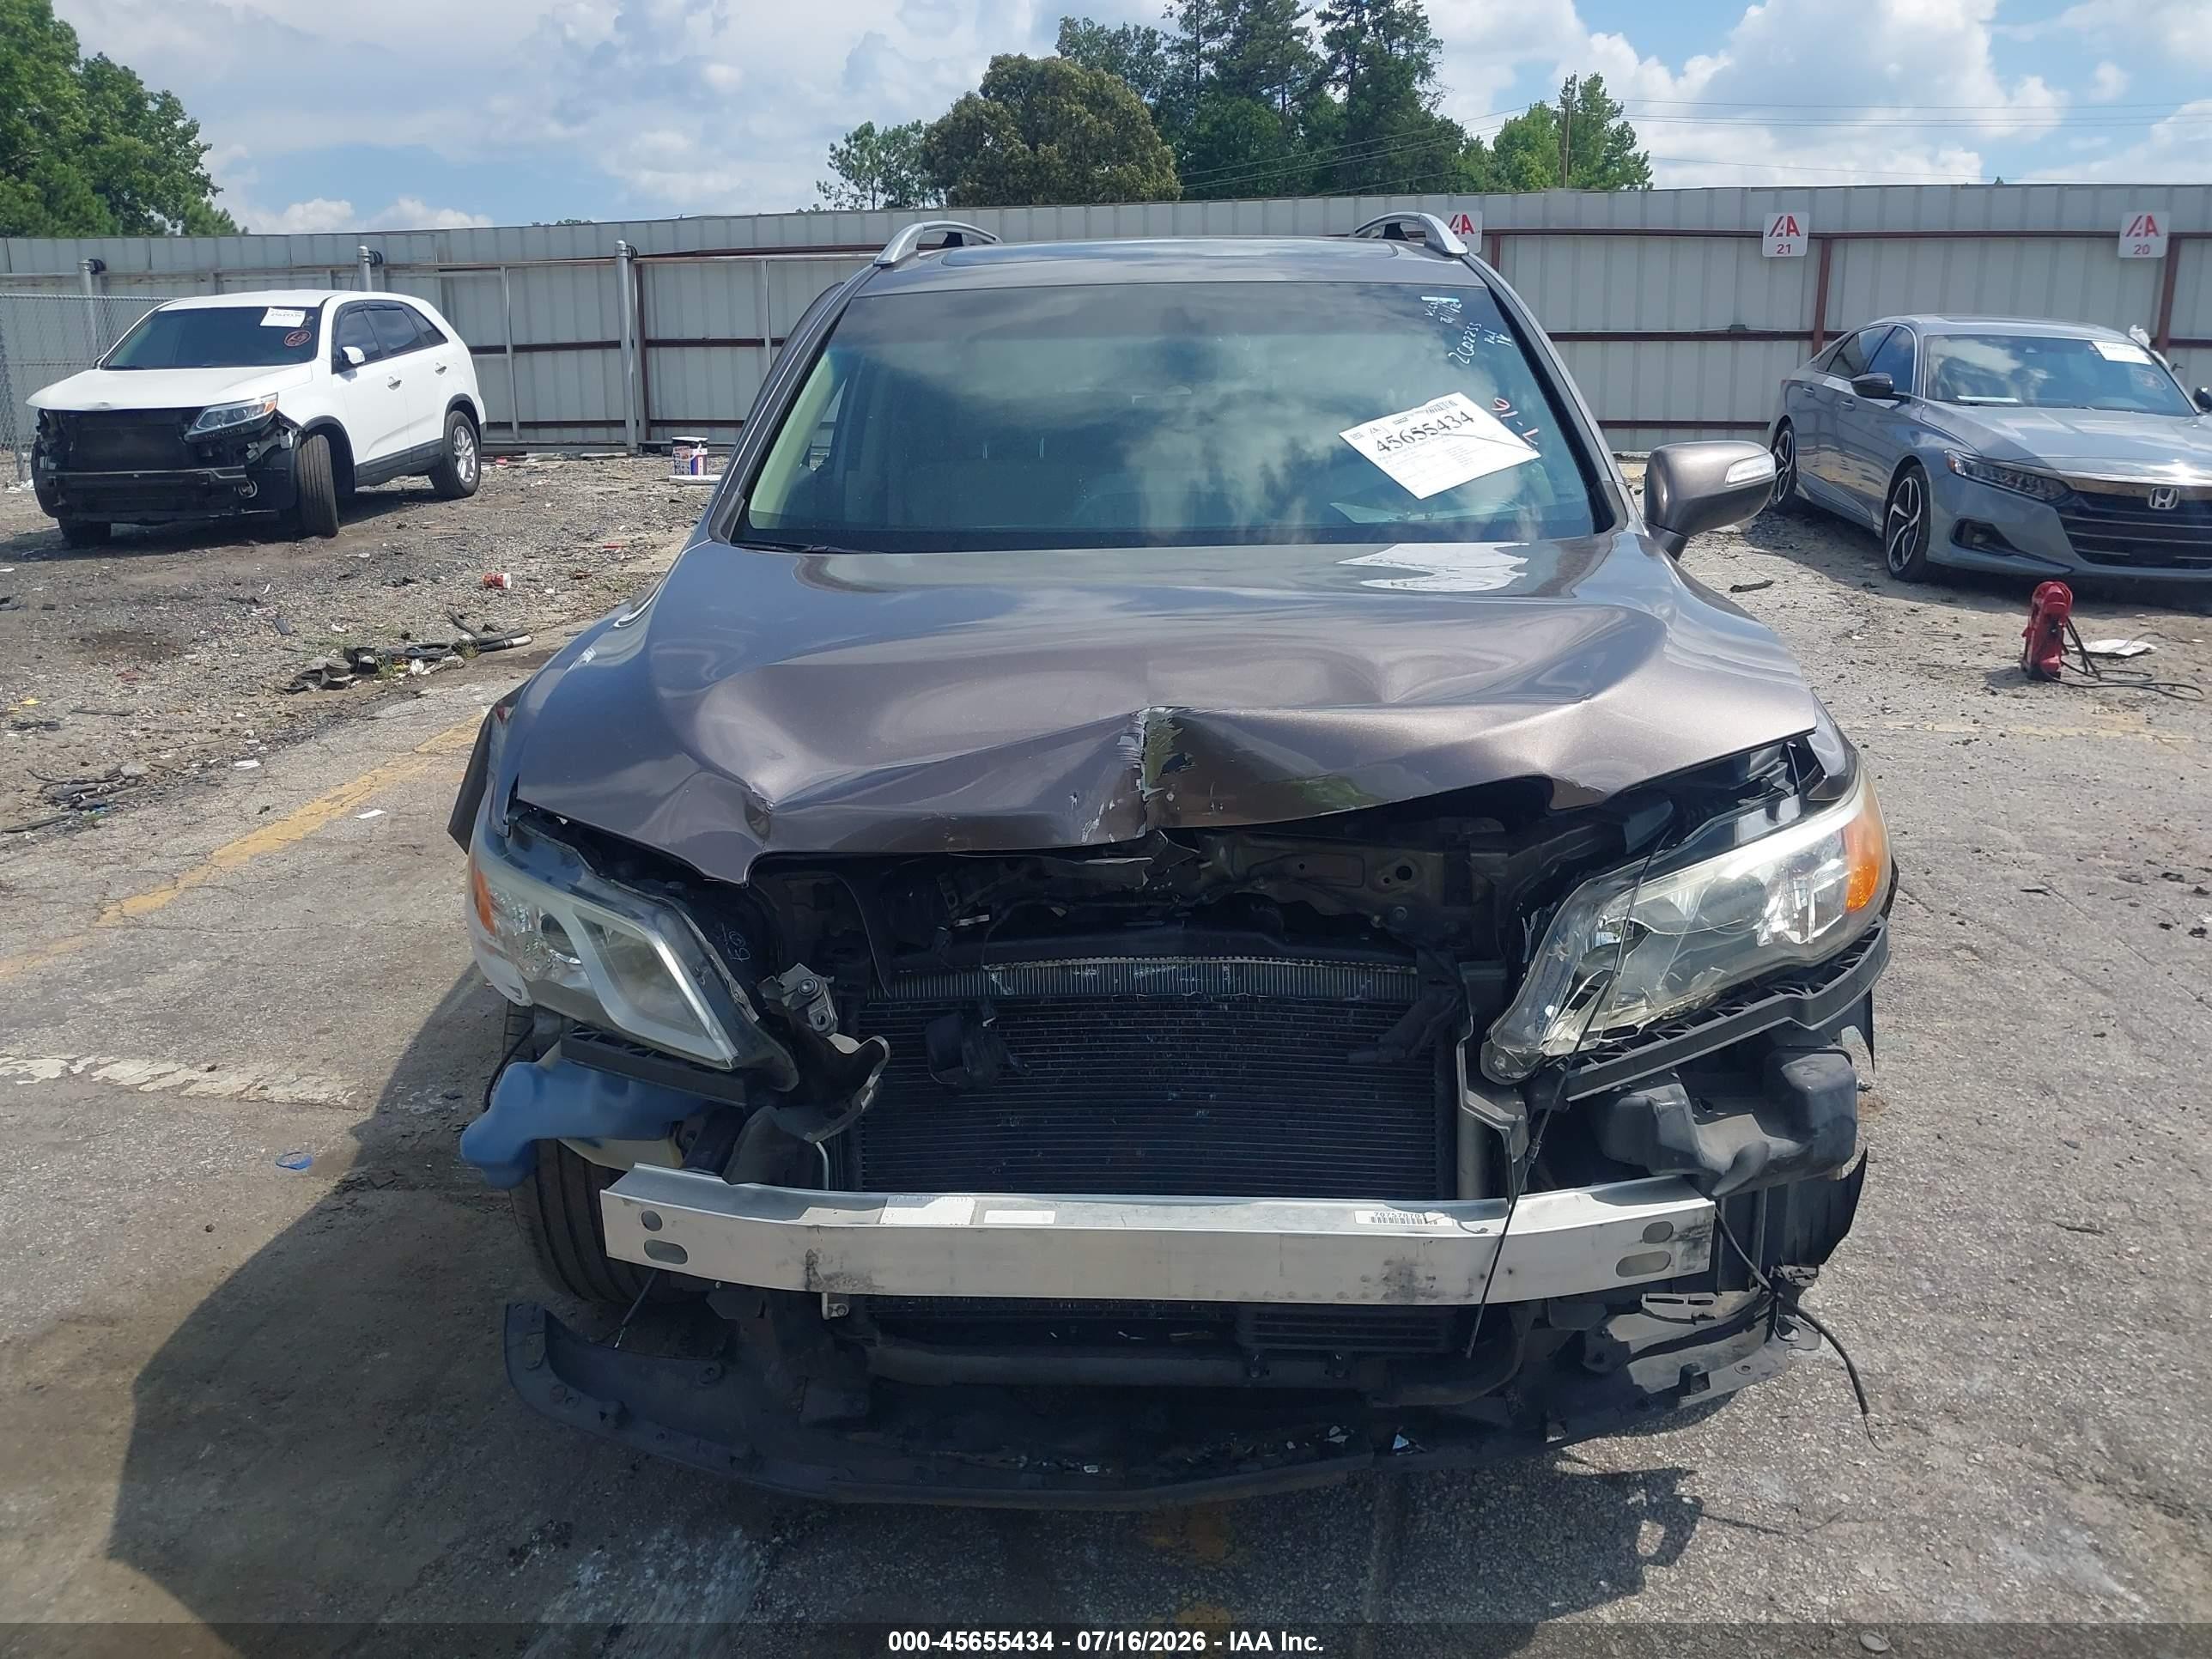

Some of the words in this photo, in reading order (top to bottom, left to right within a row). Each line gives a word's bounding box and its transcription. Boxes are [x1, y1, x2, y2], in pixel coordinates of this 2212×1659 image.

[1777, 244, 1791, 254] 21
[2133, 244, 2151, 255] 20
[1376, 410, 1474, 453] 45655434
